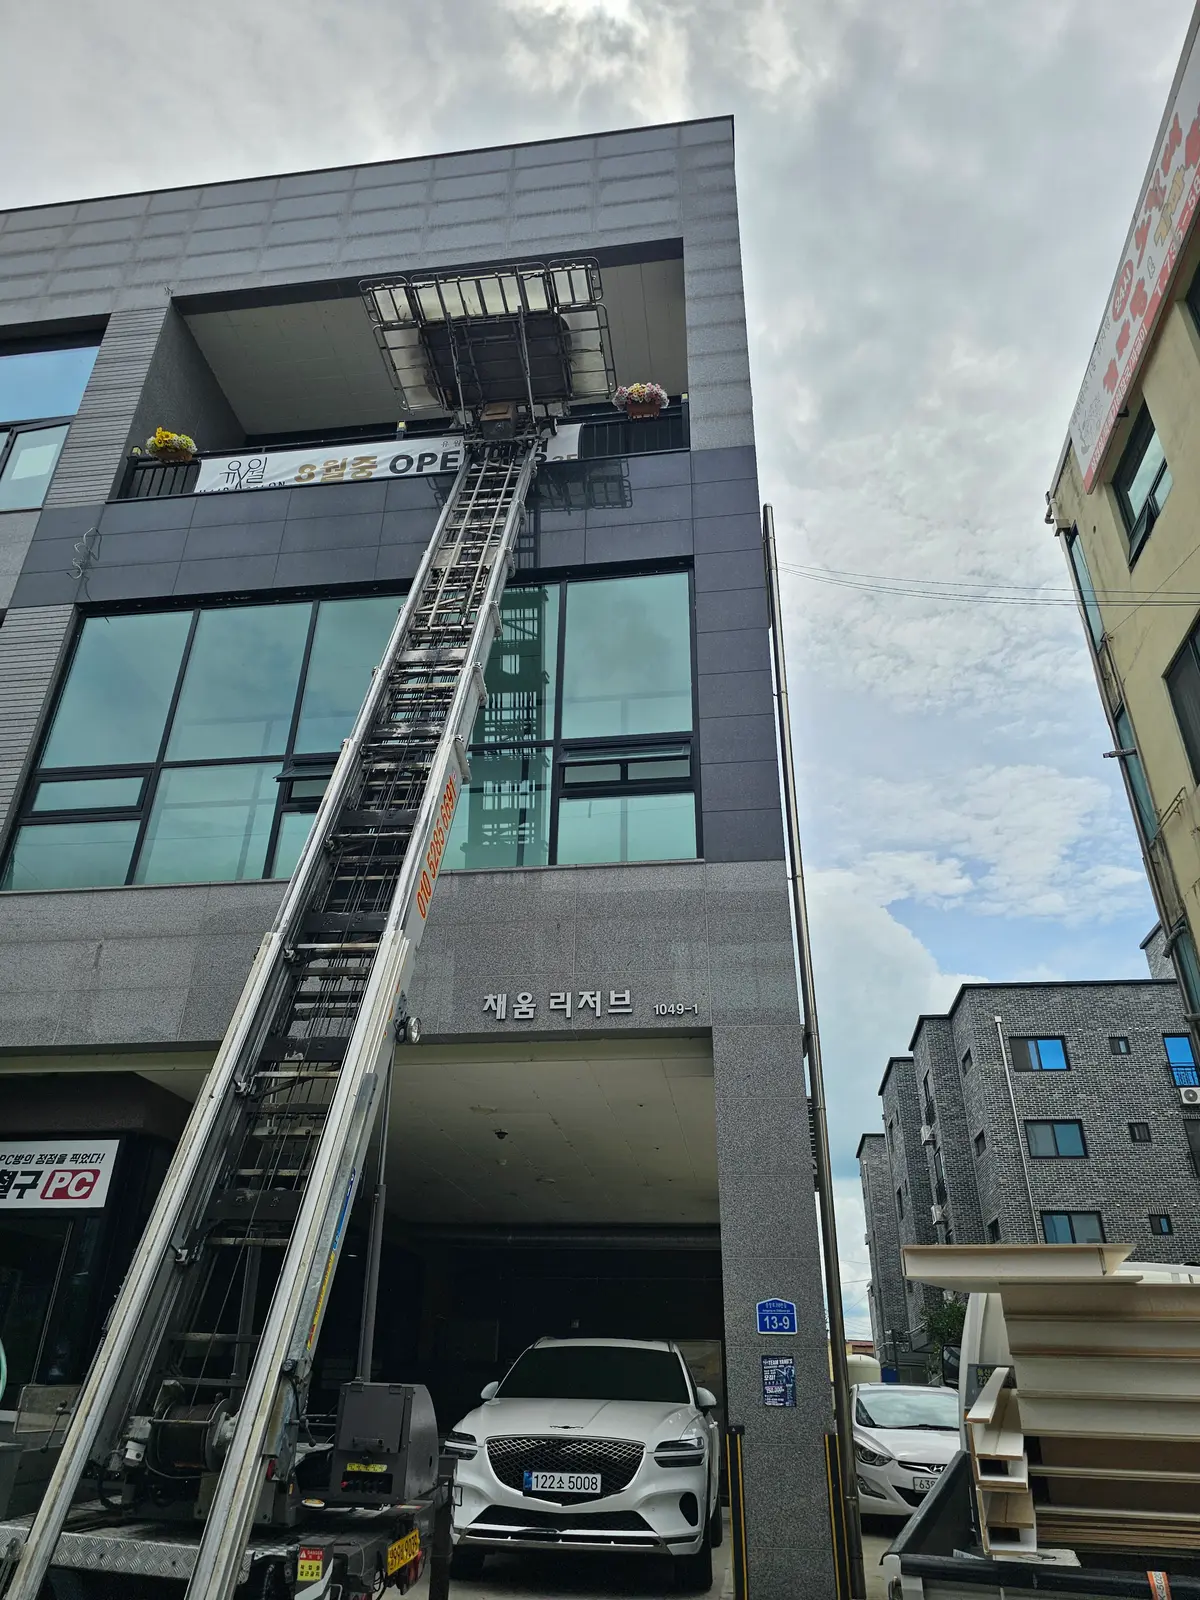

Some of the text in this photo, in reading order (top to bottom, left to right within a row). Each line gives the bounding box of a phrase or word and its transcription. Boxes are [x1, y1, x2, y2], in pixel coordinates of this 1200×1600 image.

[416, 870, 432, 919] 010
[482, 990, 698, 1019] 채움 리저브 1049-1
[36, 1153, 68, 1165] 정점을
[763, 1315, 790, 1330] 13-9
[568, 1475, 598, 1490] 5008
